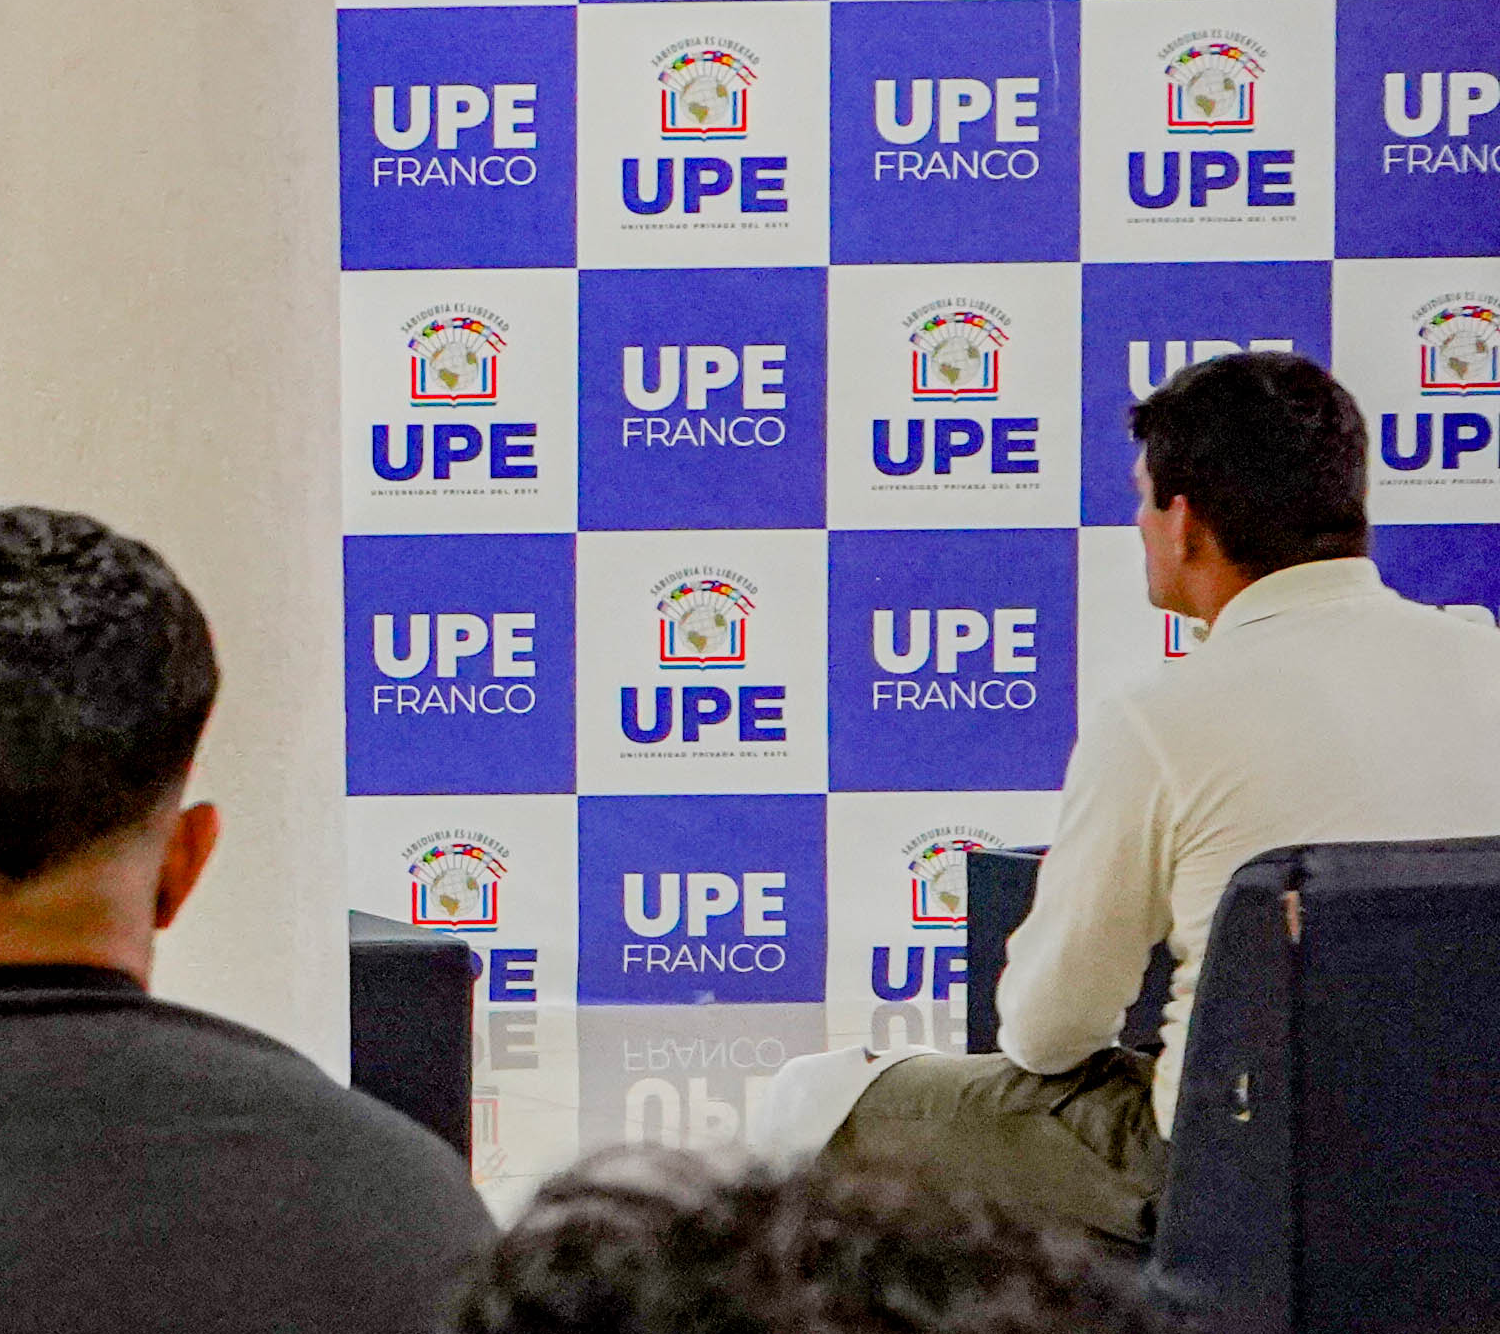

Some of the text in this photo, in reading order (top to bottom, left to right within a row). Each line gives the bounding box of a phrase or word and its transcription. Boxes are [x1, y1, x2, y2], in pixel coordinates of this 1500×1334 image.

[373, 83, 537, 151] UPE
[875, 77, 1040, 144] UPE
[1384, 72, 1500, 138] UP
[373, 156, 537, 186] FRANCO
[621, 156, 787, 214] UPE
[875, 150, 1040, 180] FRANCO
[1128, 149, 1295, 208] UPE
[401, 303, 451, 334] SABIDURIA
[623, 344, 786, 411] UPE
[372, 422, 538, 481] UPE
[623, 417, 786, 447] FRANCO
[872, 417, 1039, 476] UPE
[1380, 412, 1499, 471] UP
[650, 566, 700, 597] SABIDURIA
[373, 613, 536, 678] UPE
[873, 609, 1037, 674] UPE
[373, 684, 536, 714] FRANCO
[620, 685, 786, 744] UPE
[873, 680, 1037, 710] FRANCO
[402, 830, 451, 859] SABIDURIA
[623, 872, 786, 938] UPE
[623, 943, 786, 973] FRANCO
[872, 946, 967, 1001] UP
